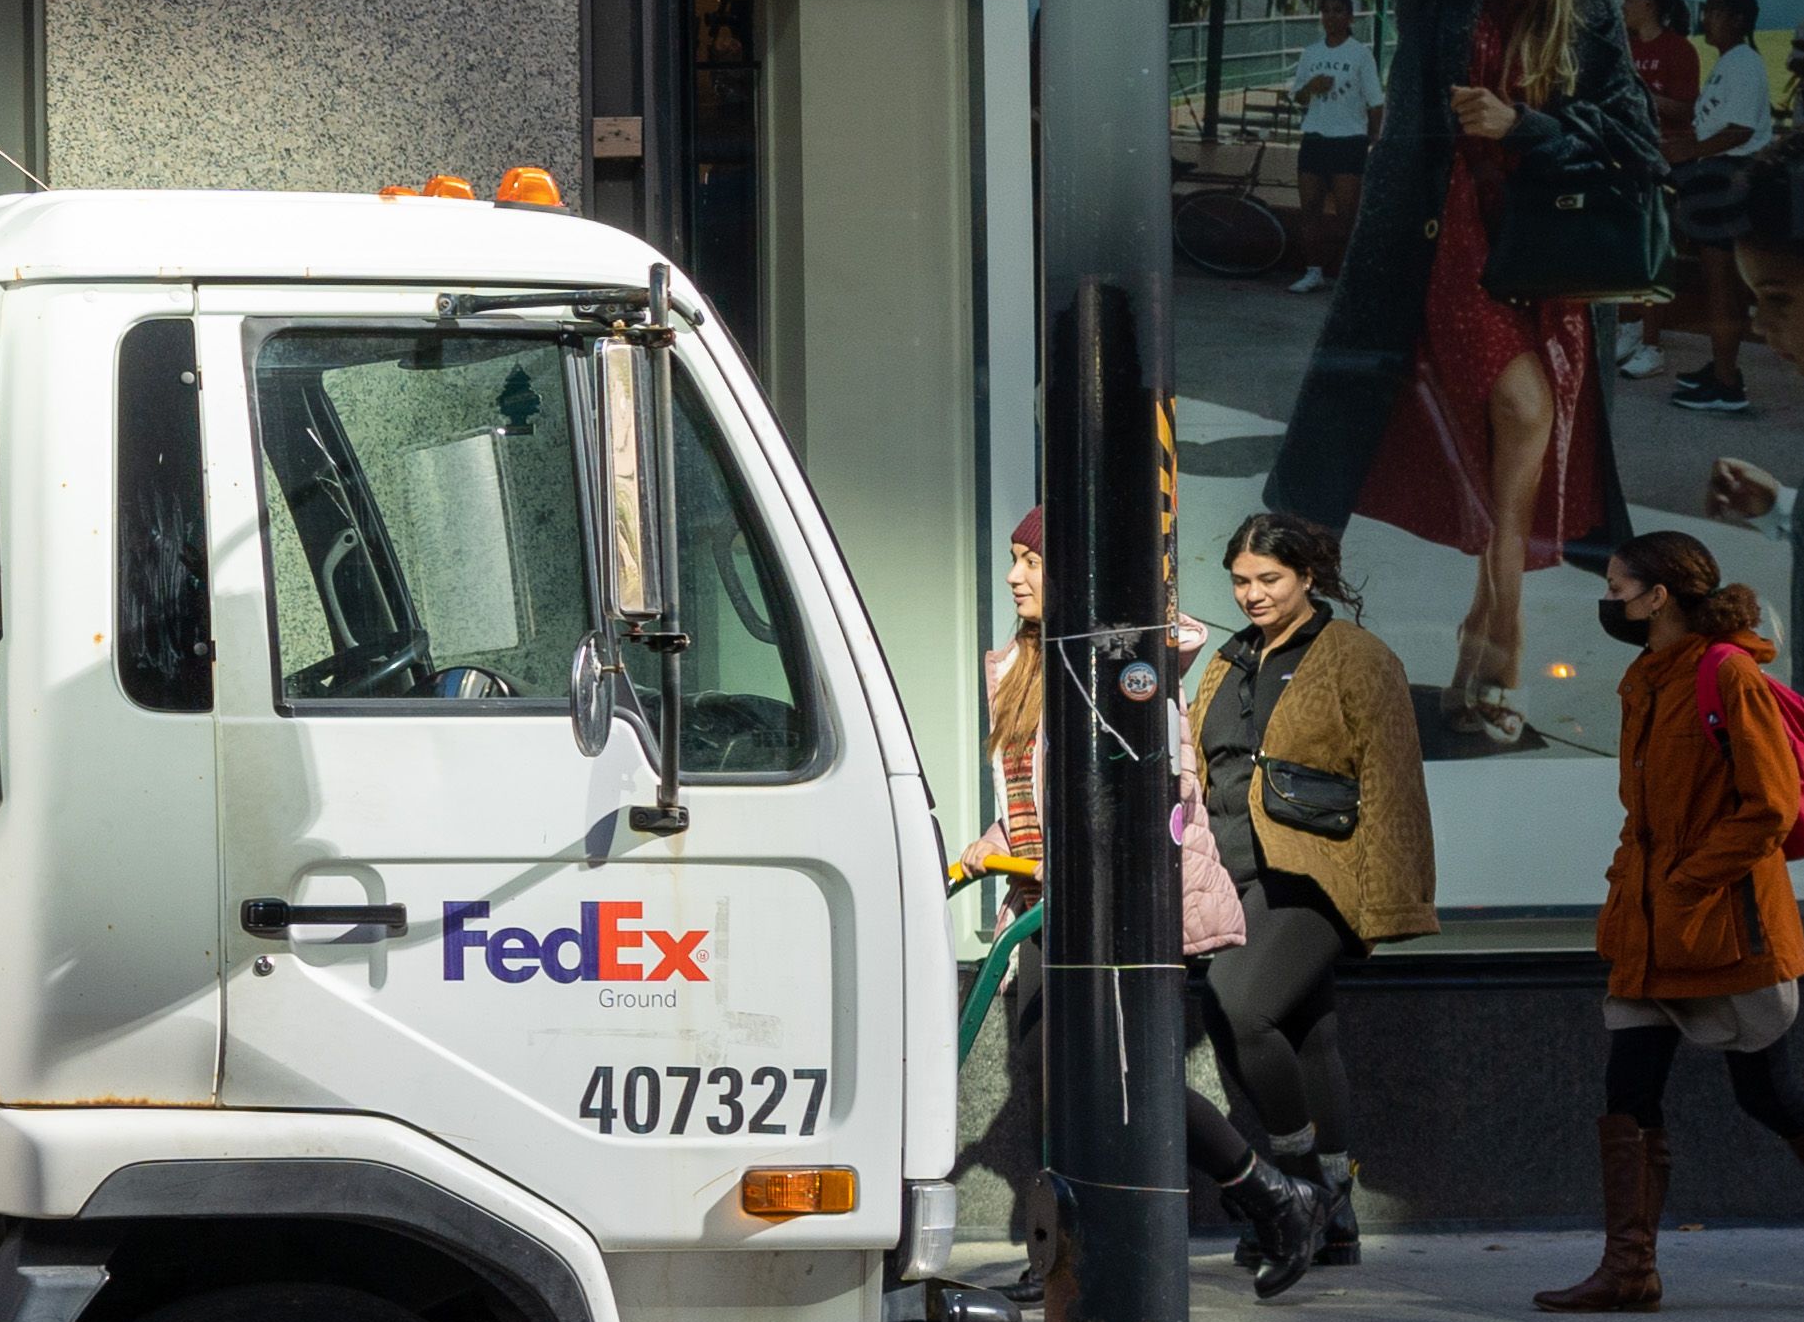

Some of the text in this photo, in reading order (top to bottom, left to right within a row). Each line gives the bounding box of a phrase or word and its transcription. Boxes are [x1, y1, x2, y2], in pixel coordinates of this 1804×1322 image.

[442, 900, 711, 984] FedEx
[598, 987, 677, 1008] Ground
[578, 1065, 828, 1137] 407327
